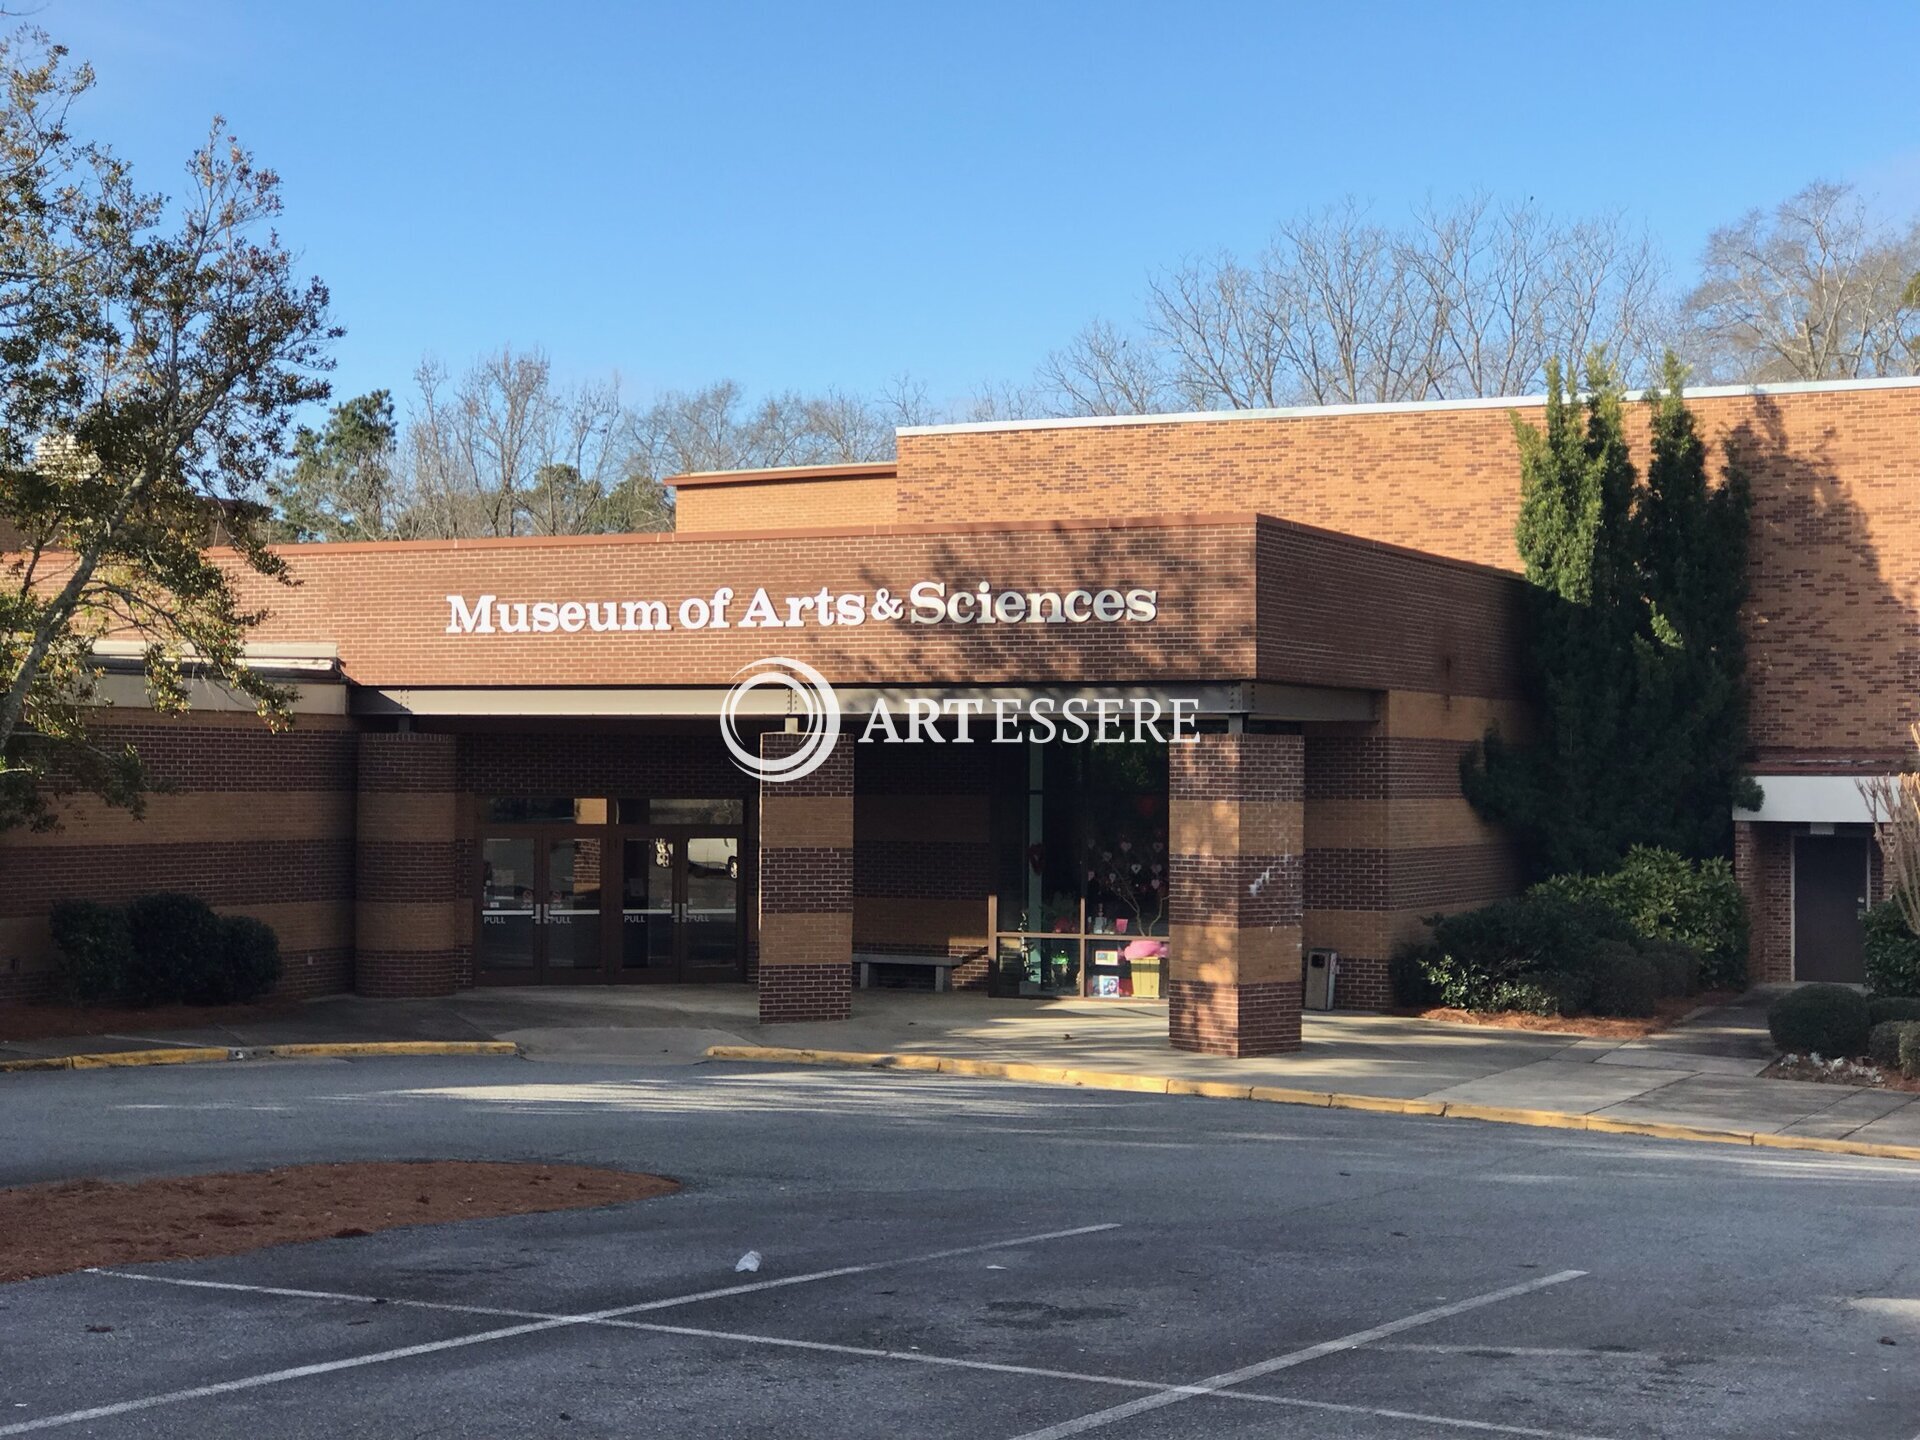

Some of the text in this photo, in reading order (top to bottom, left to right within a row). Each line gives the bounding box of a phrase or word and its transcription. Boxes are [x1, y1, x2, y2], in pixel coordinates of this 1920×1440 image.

[446, 581, 1158, 633] Museum of Arts & Sciences
[483, 916, 506, 925] PULL
[623, 915, 646, 923] PULL
